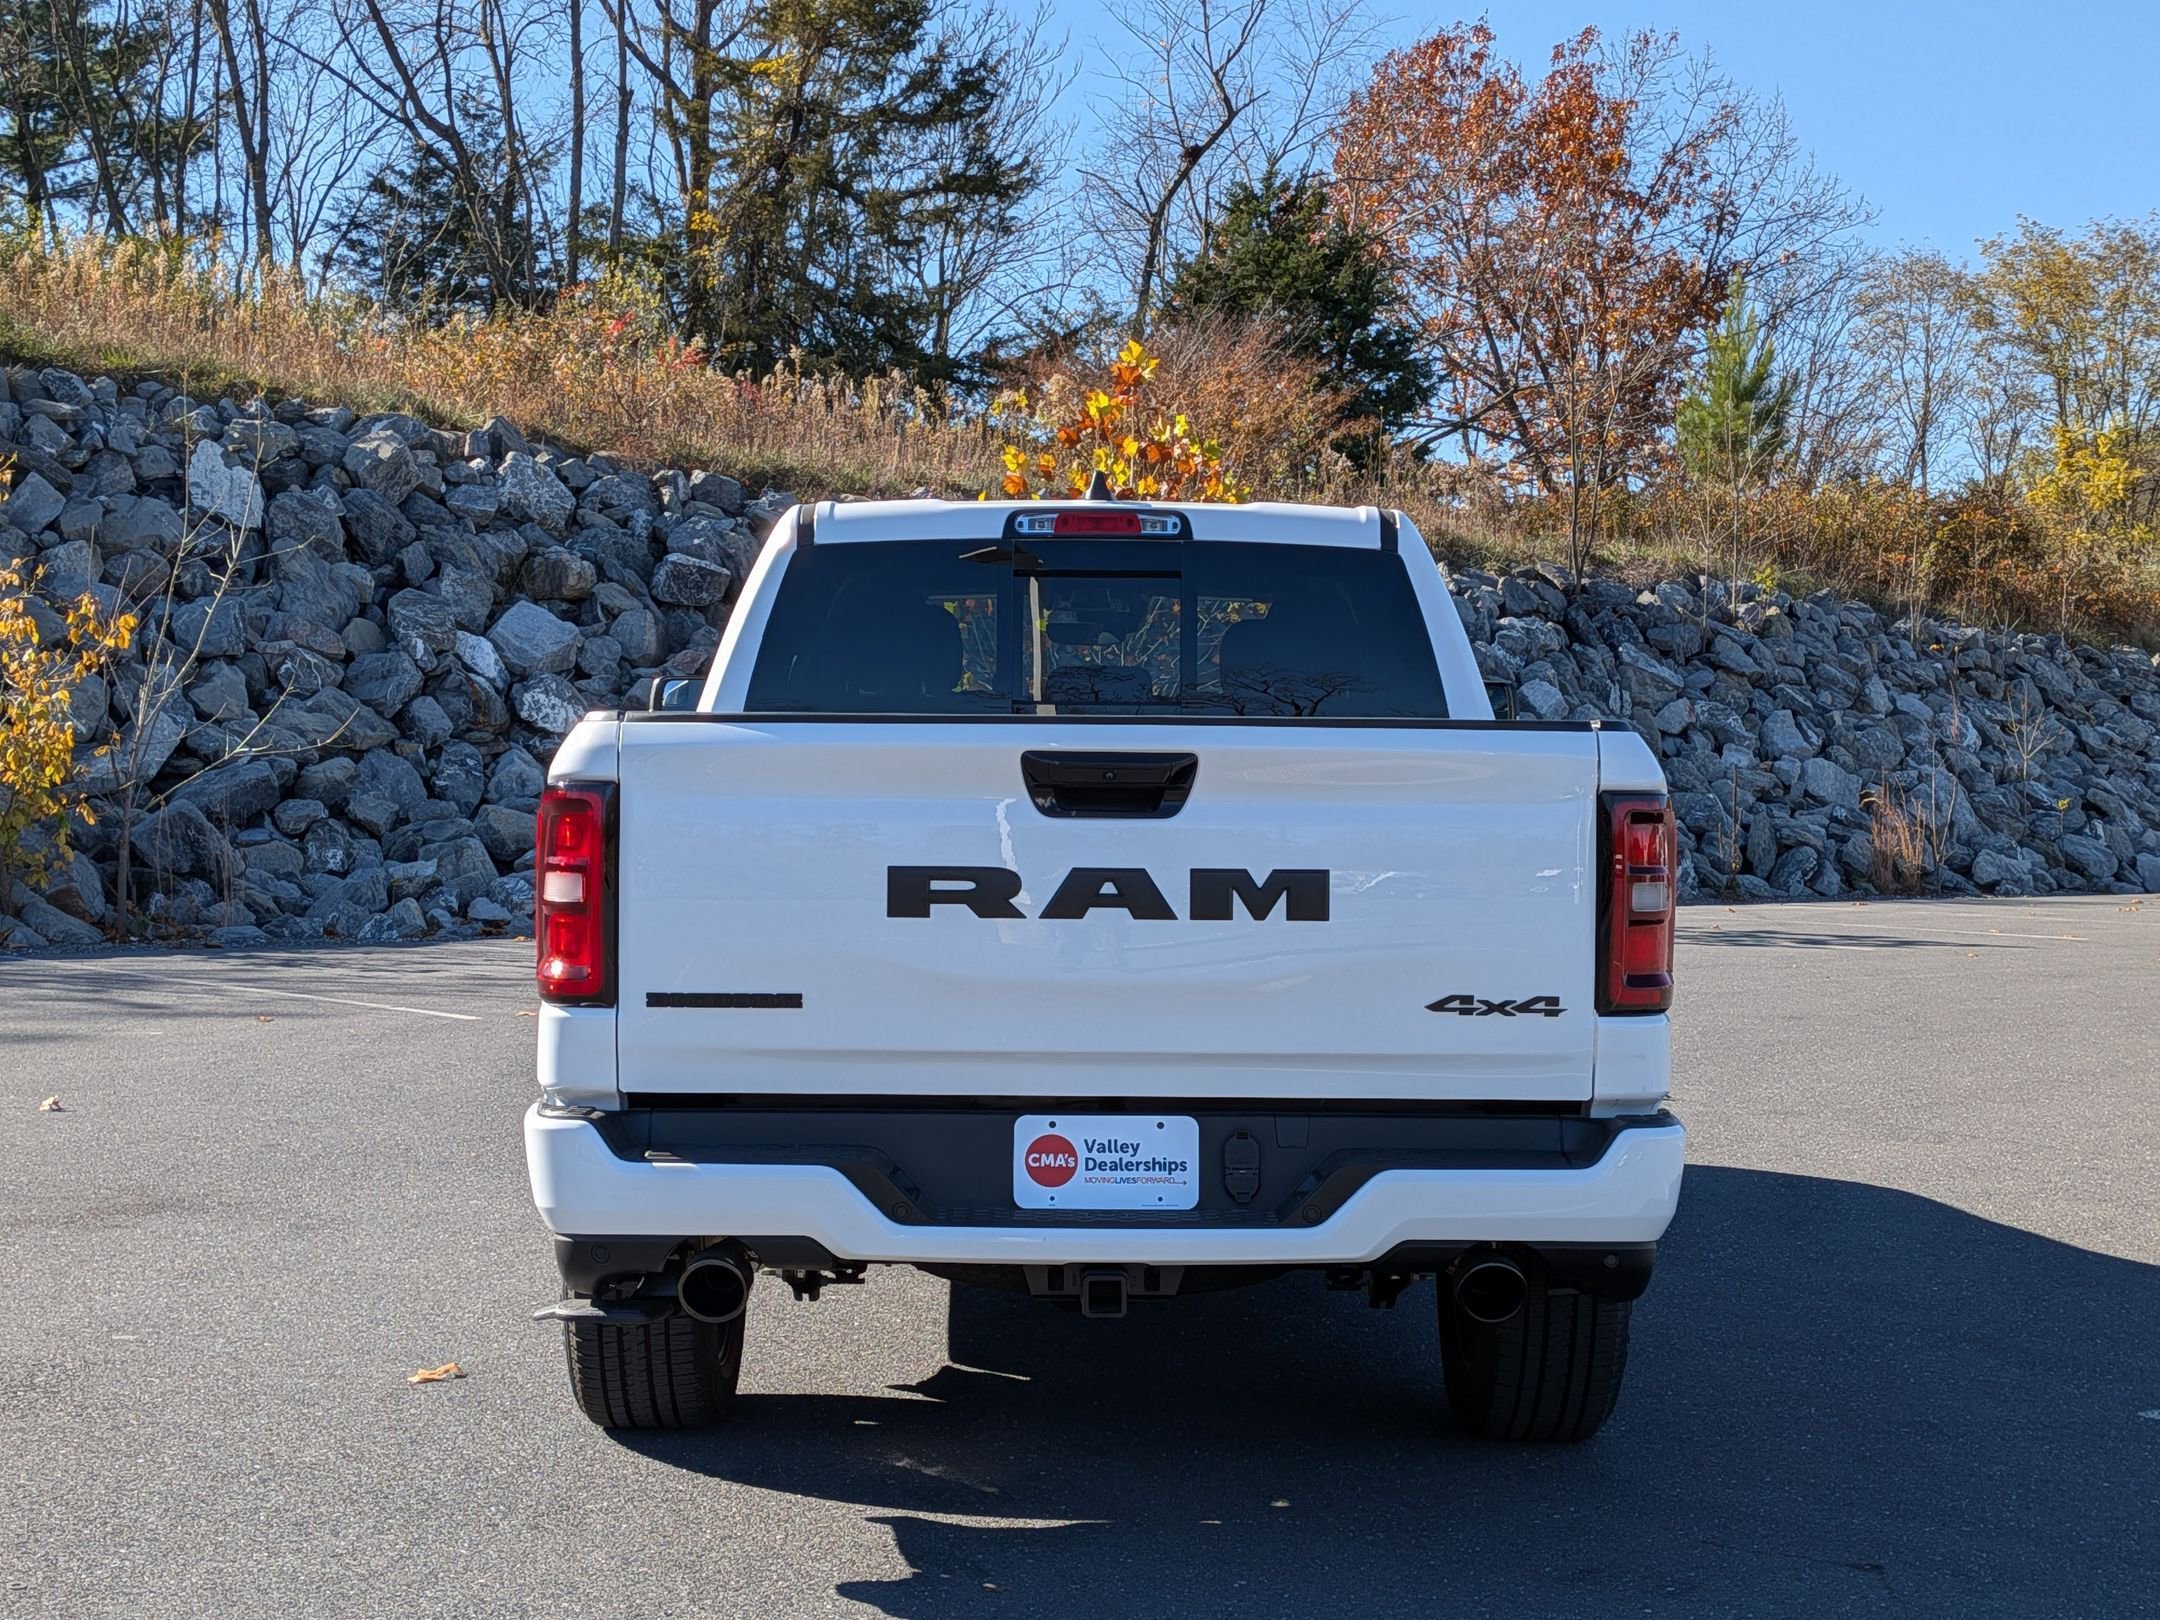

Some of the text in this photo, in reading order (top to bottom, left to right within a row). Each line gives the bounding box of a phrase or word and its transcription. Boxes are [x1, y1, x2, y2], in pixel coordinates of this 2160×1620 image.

[887, 865, 1330, 921] RAM
[1424, 994, 1568, 1017] 4x4
[1084, 1139, 1141, 1157] Valley
[1028, 1152, 1076, 1168] CMA's
[1084, 1157, 1188, 1175] Dealerships
